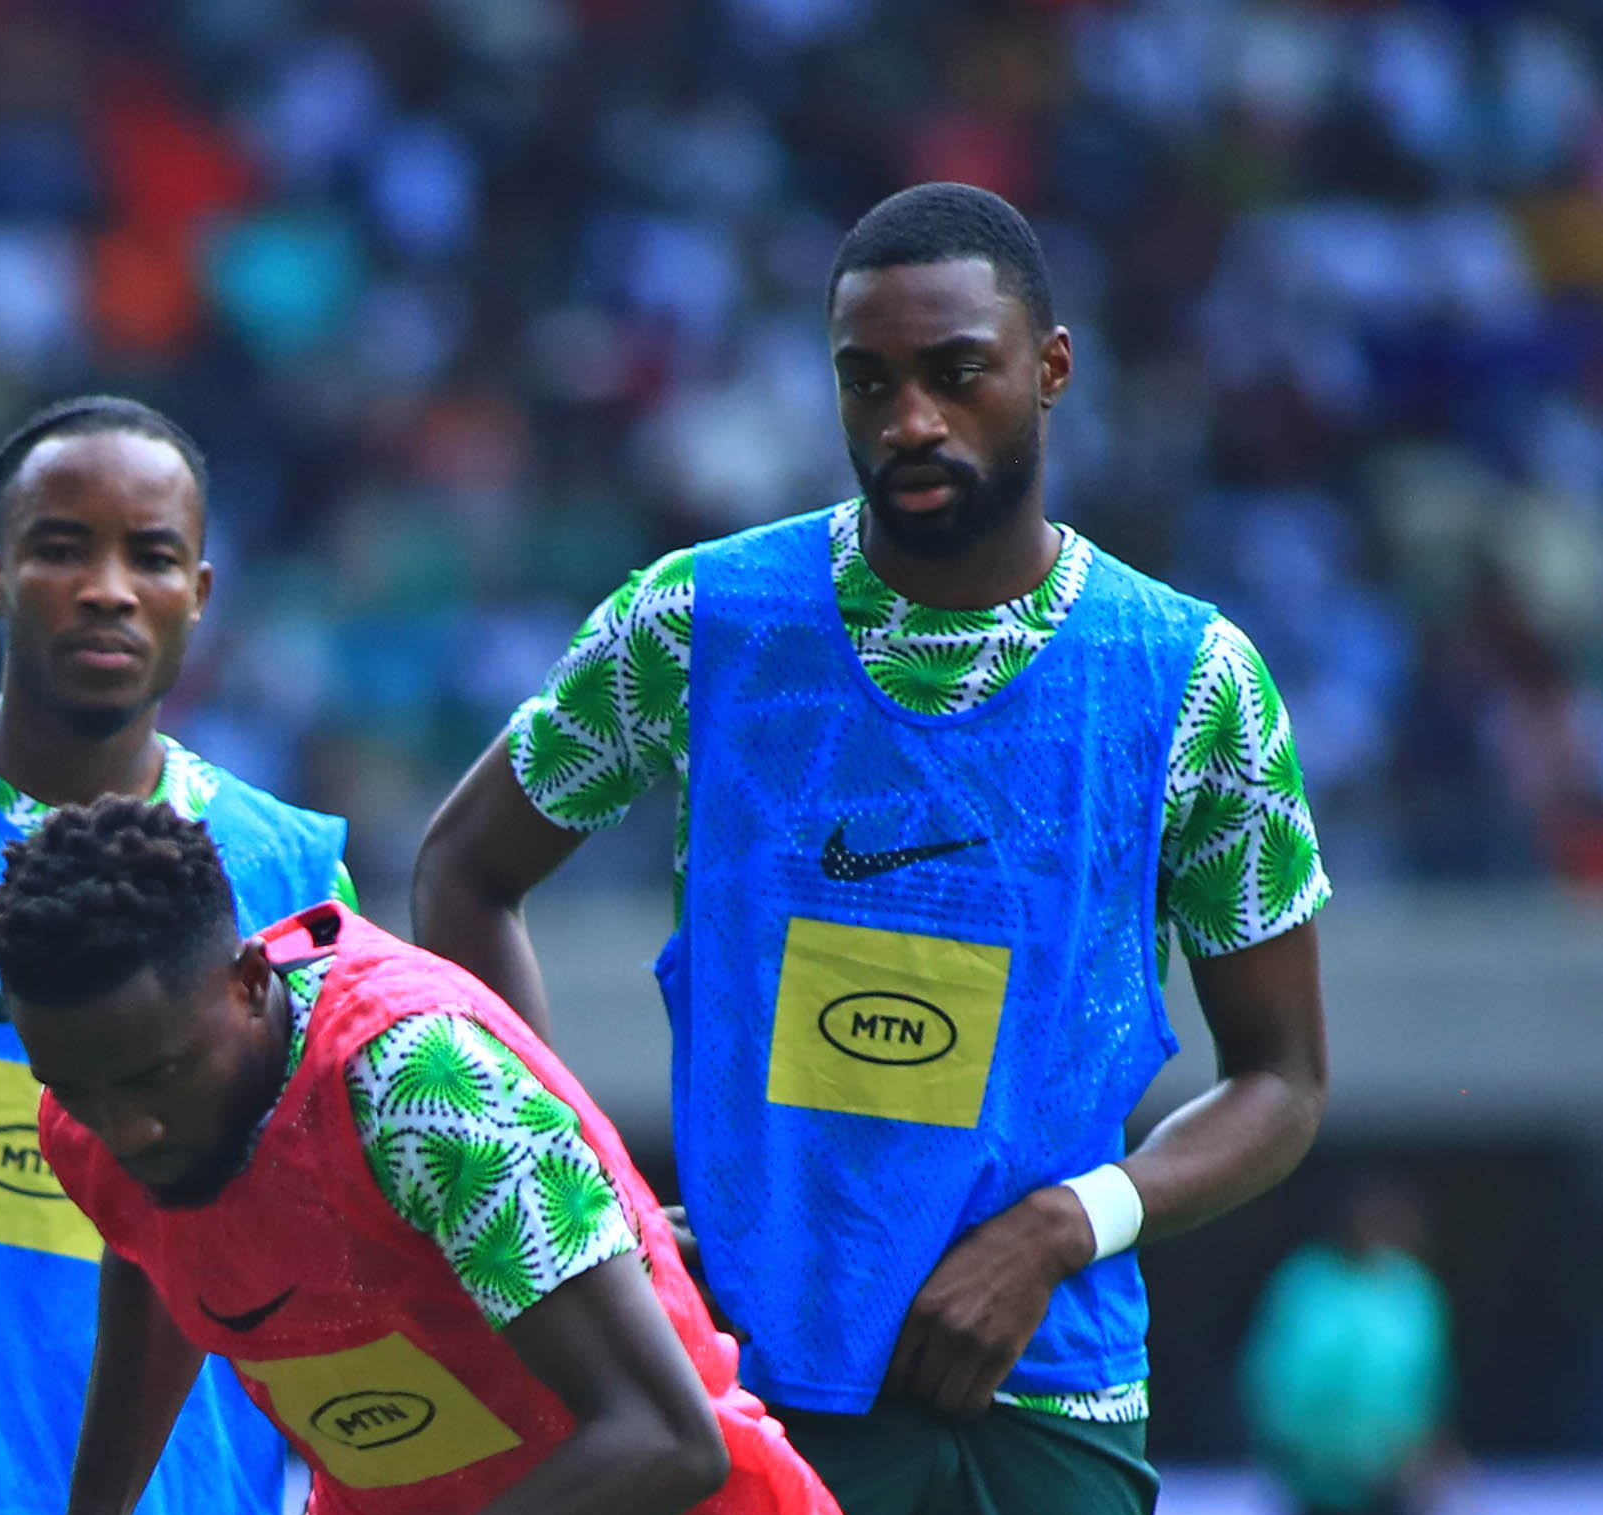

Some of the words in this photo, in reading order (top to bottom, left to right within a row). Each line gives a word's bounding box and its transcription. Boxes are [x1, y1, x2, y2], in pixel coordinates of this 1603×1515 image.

[851, 1011, 925, 1046] MTN
[1, 1143, 55, 1175] MT
[334, 1402, 409, 1437] MTN
